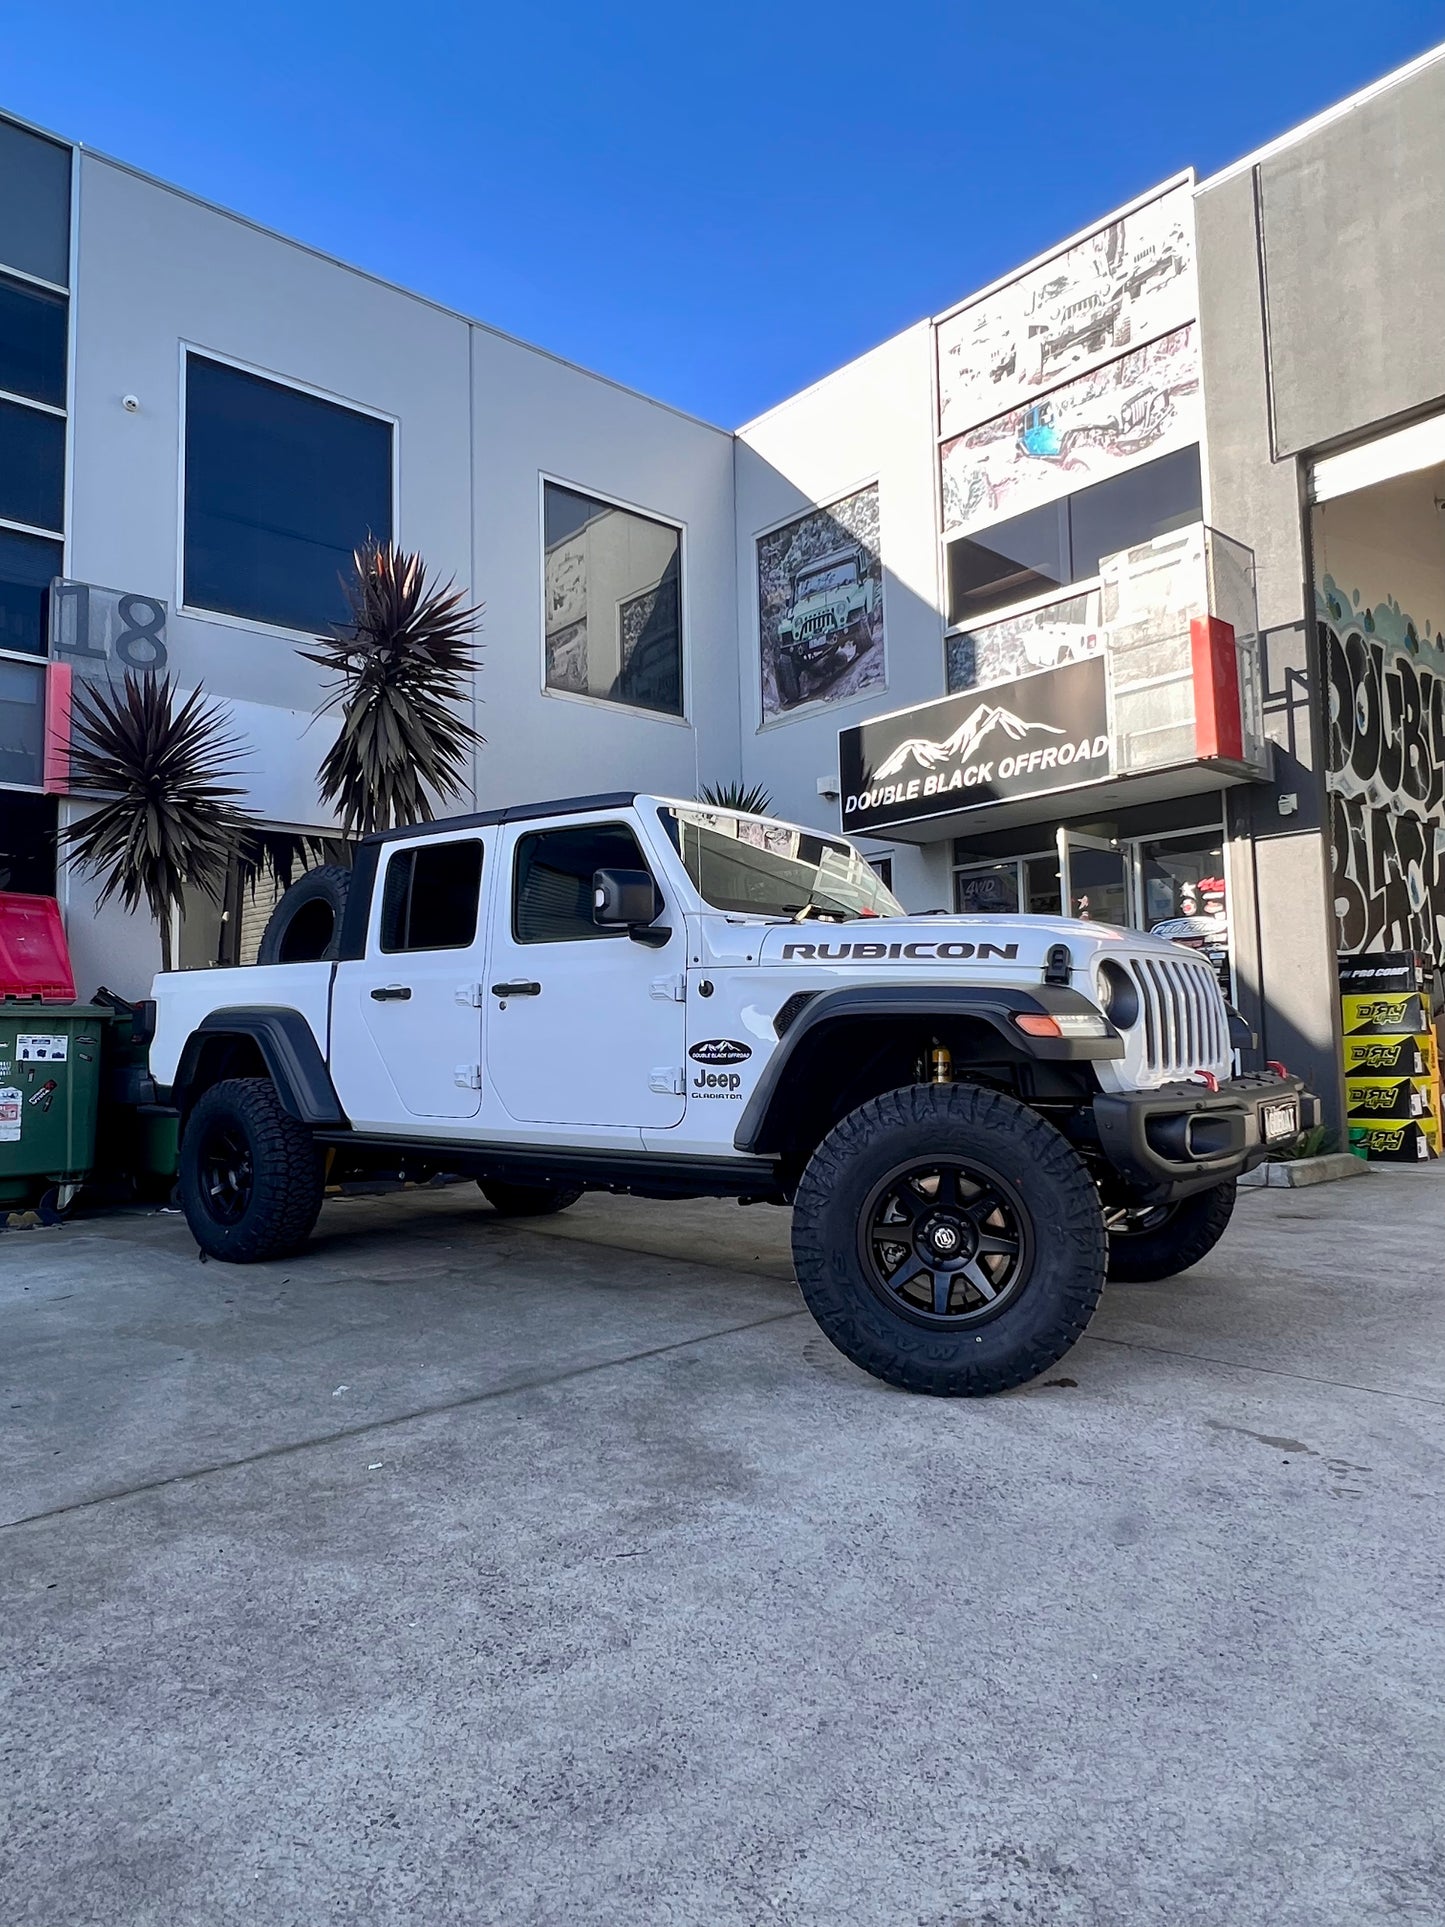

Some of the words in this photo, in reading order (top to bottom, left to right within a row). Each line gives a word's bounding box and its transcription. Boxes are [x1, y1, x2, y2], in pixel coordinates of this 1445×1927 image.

[53, 585, 168, 670] 18
[845, 779, 920, 814] DOUBLE
[923, 762, 994, 796] BLACK
[998, 736, 1109, 779] OFFROAD
[964, 879, 995, 897] 4WD
[782, 943, 1019, 960] RUBICON
[1352, 969, 1375, 978] PRO
[1375, 966, 1409, 977] COMP
[1355, 1003, 1407, 1019] DIRTY
[1351, 1046, 1401, 1061] DIRTY
[693, 1069, 741, 1091] Jeep
[691, 1092, 743, 1100] GLADIATOR
[1348, 1087, 1398, 1102] DIRTY
[1366, 1130, 1404, 1143] IRTY
